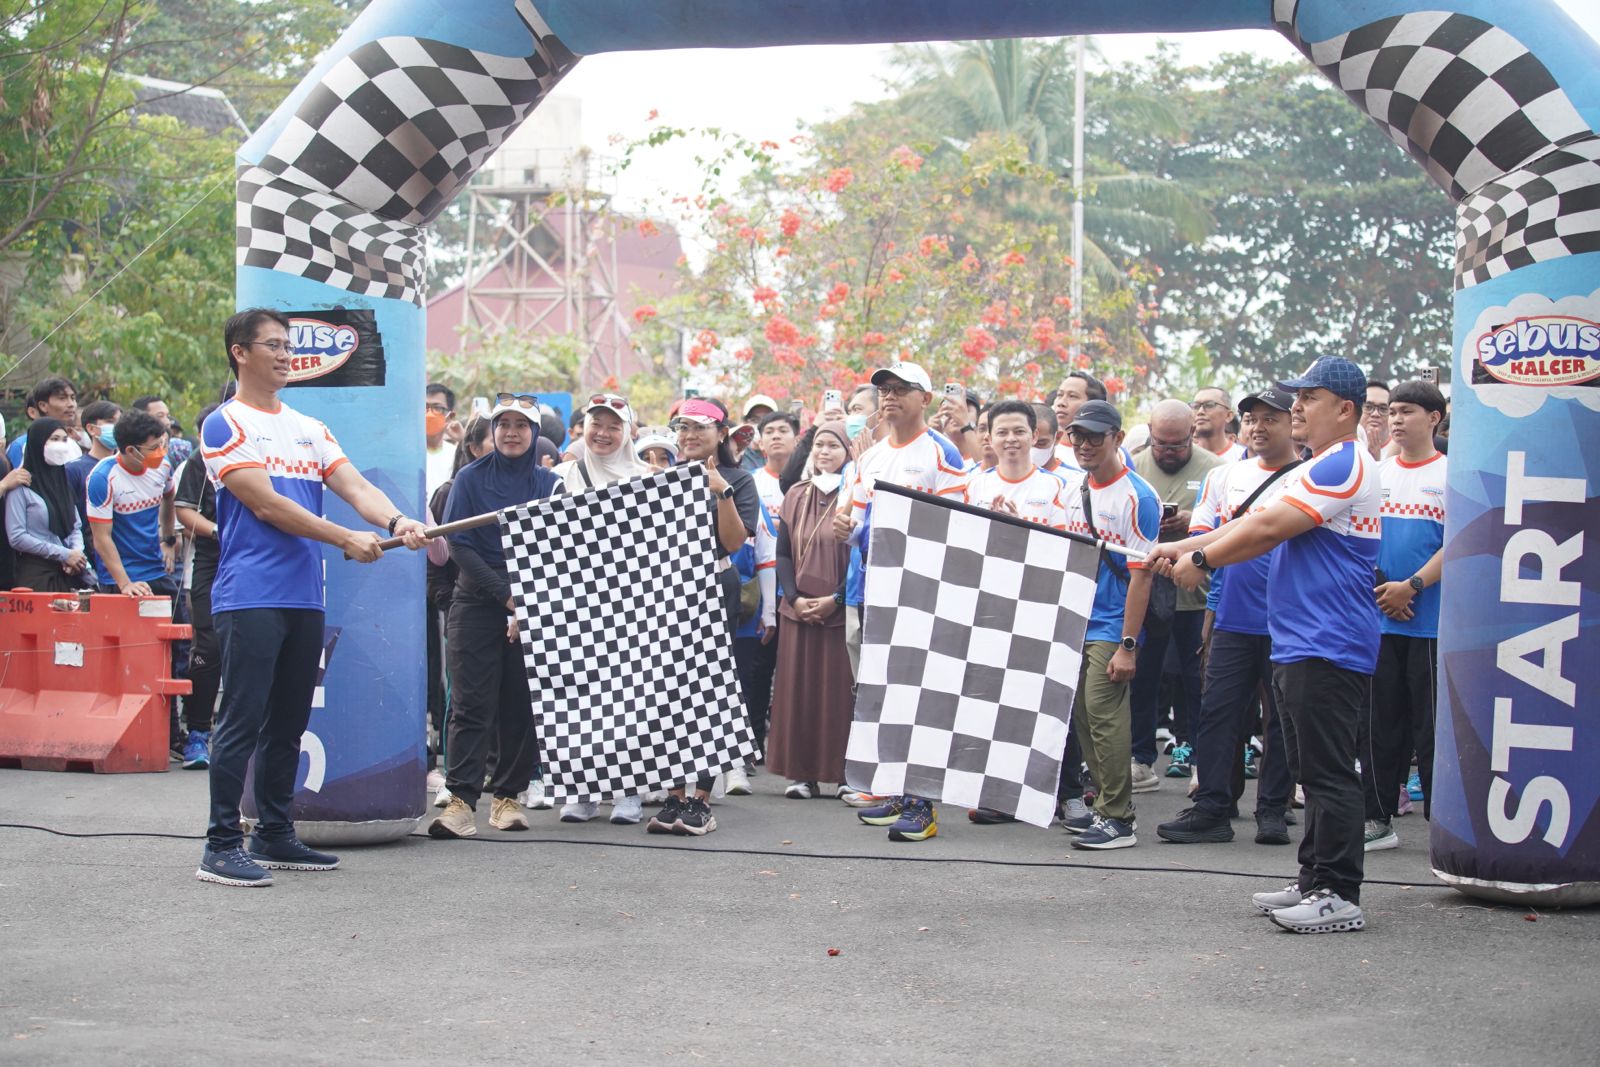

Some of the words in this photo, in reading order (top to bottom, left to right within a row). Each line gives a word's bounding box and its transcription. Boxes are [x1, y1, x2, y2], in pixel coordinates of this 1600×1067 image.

[288, 325, 356, 353] use
[290, 356, 322, 371] CER
[1510, 359, 1586, 376] KALCER
[1486, 451, 1587, 849] START
